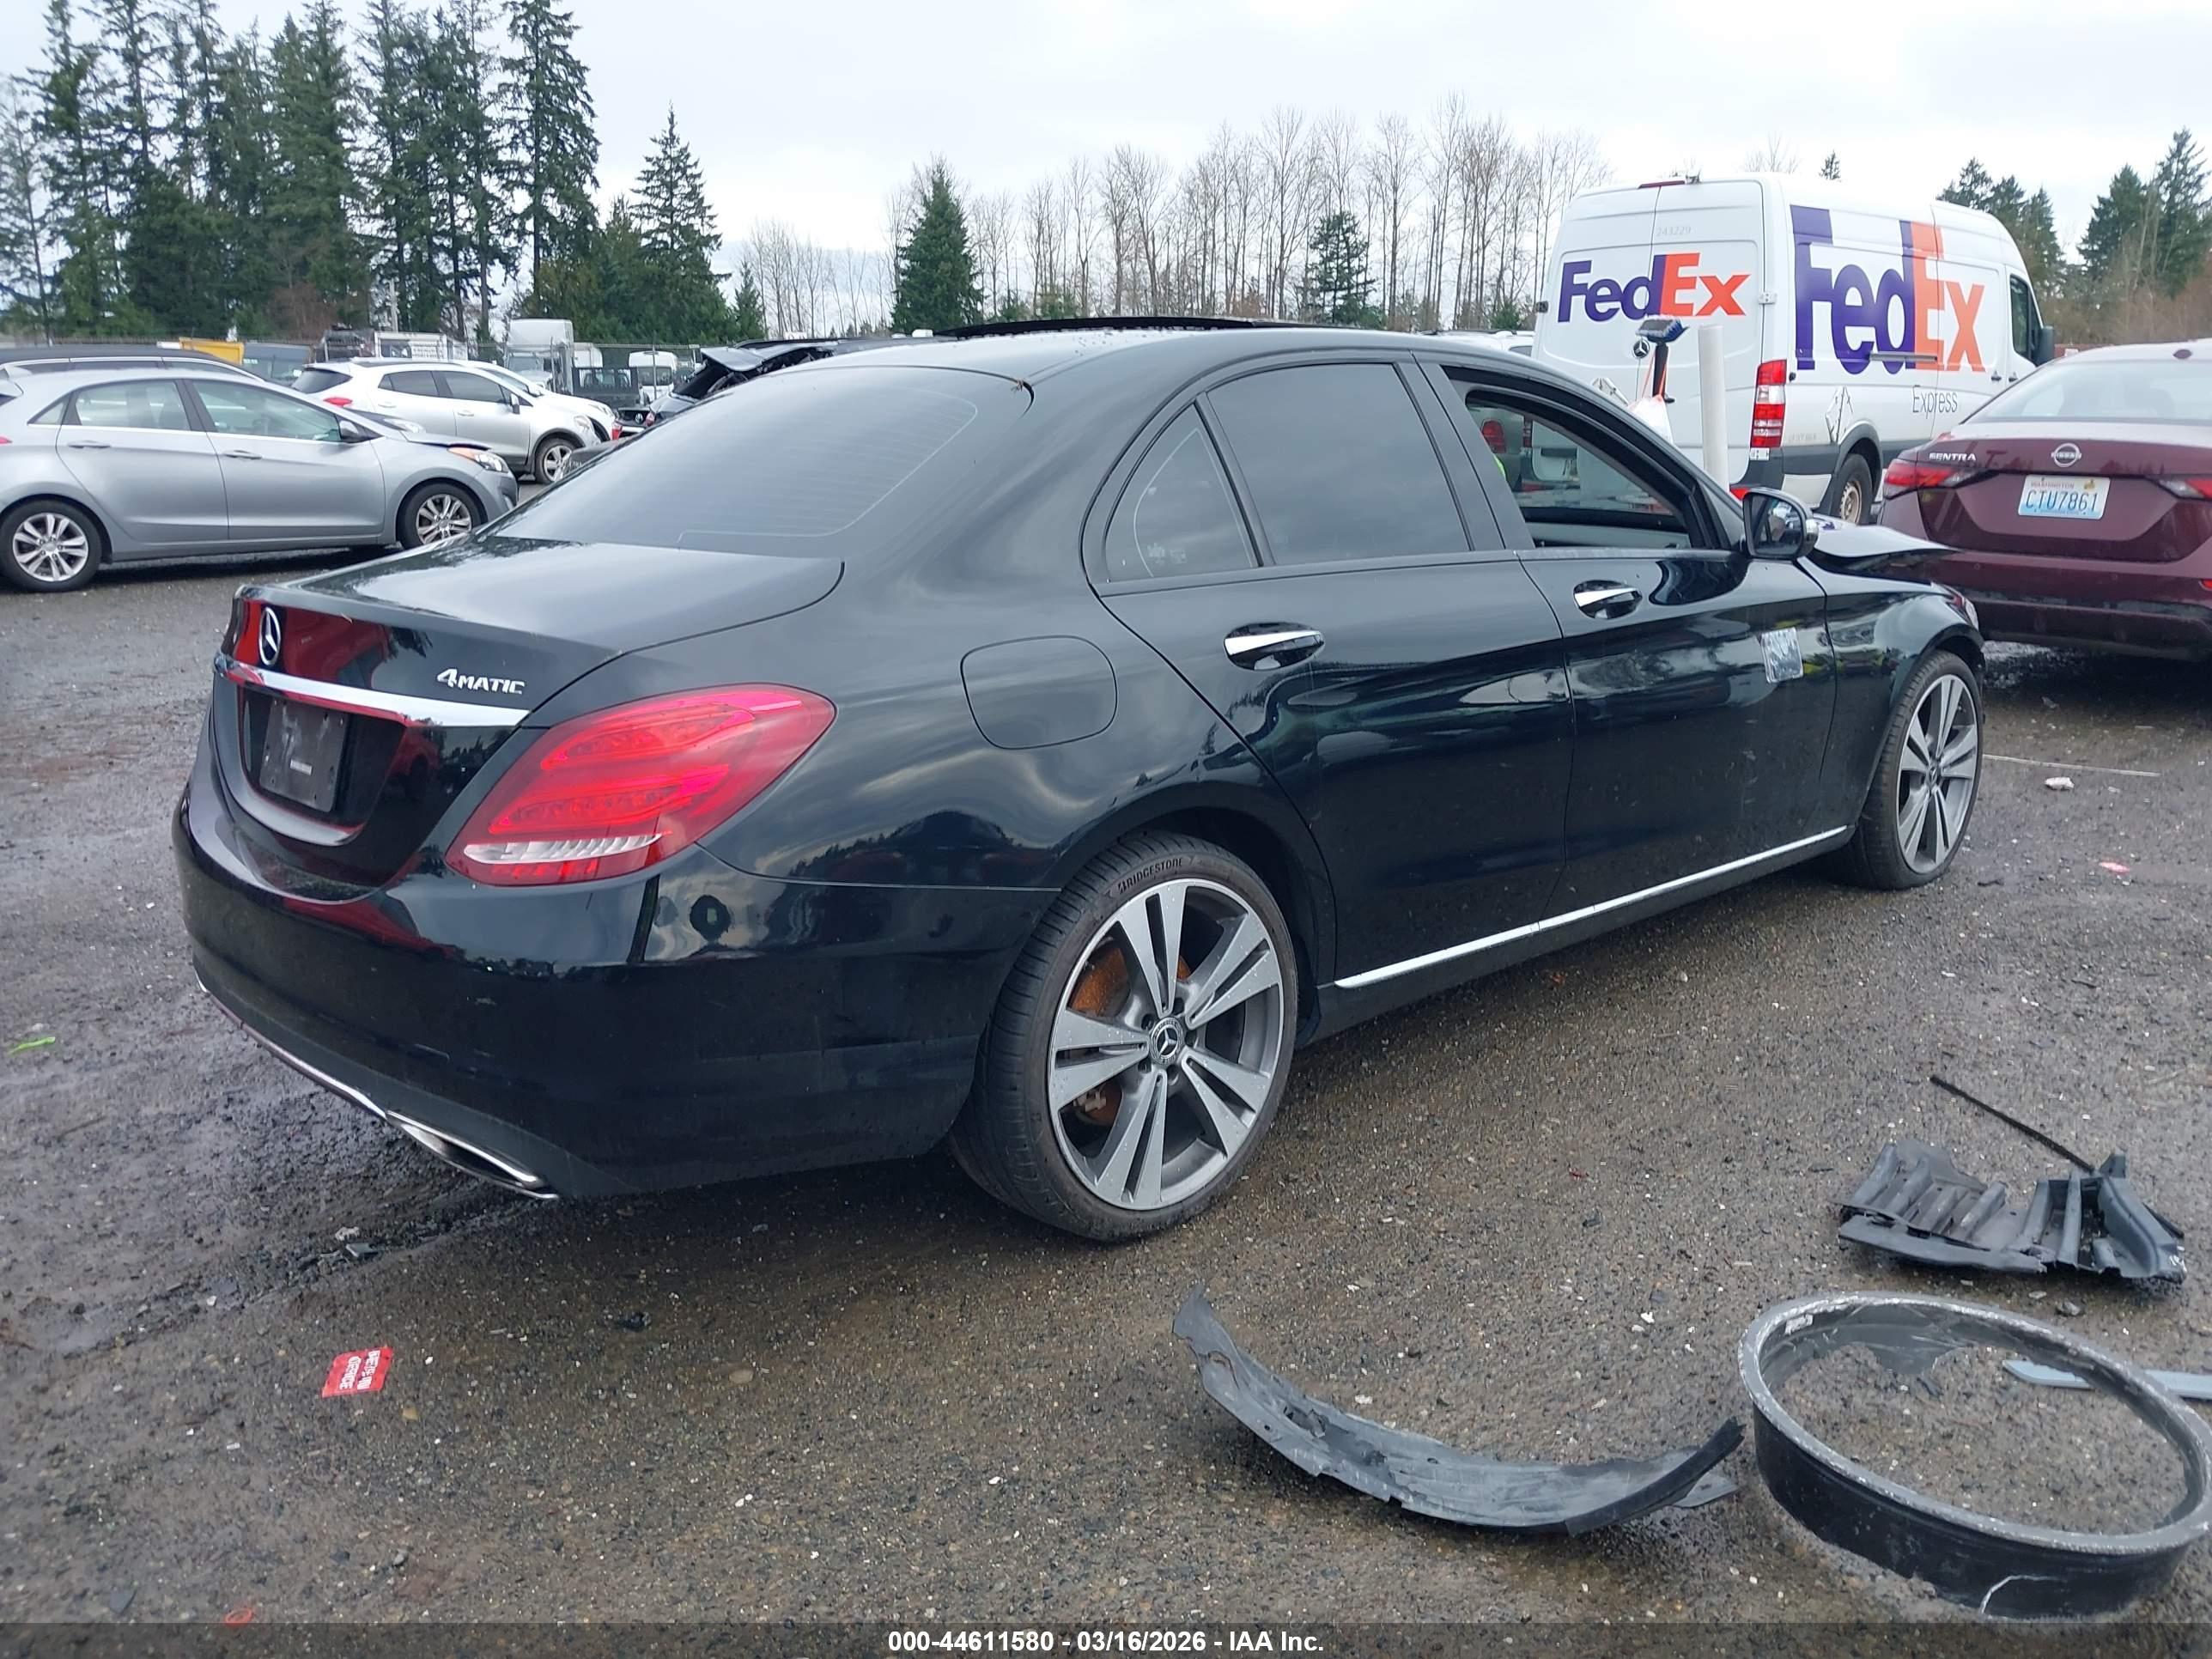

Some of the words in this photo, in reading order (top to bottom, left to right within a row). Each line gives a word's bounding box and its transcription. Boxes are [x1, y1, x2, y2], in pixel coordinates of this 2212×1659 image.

[1558, 252, 1752, 323] FedEx
[1790, 204, 1986, 374] FedEx
[1912, 384, 1958, 420] Express
[1929, 452, 1977, 462] SENTRA
[2026, 489, 2099, 513] CTU7861
[436, 668, 526, 696] 4MATIC
[1117, 858, 1184, 894] BRIDGESTONE
